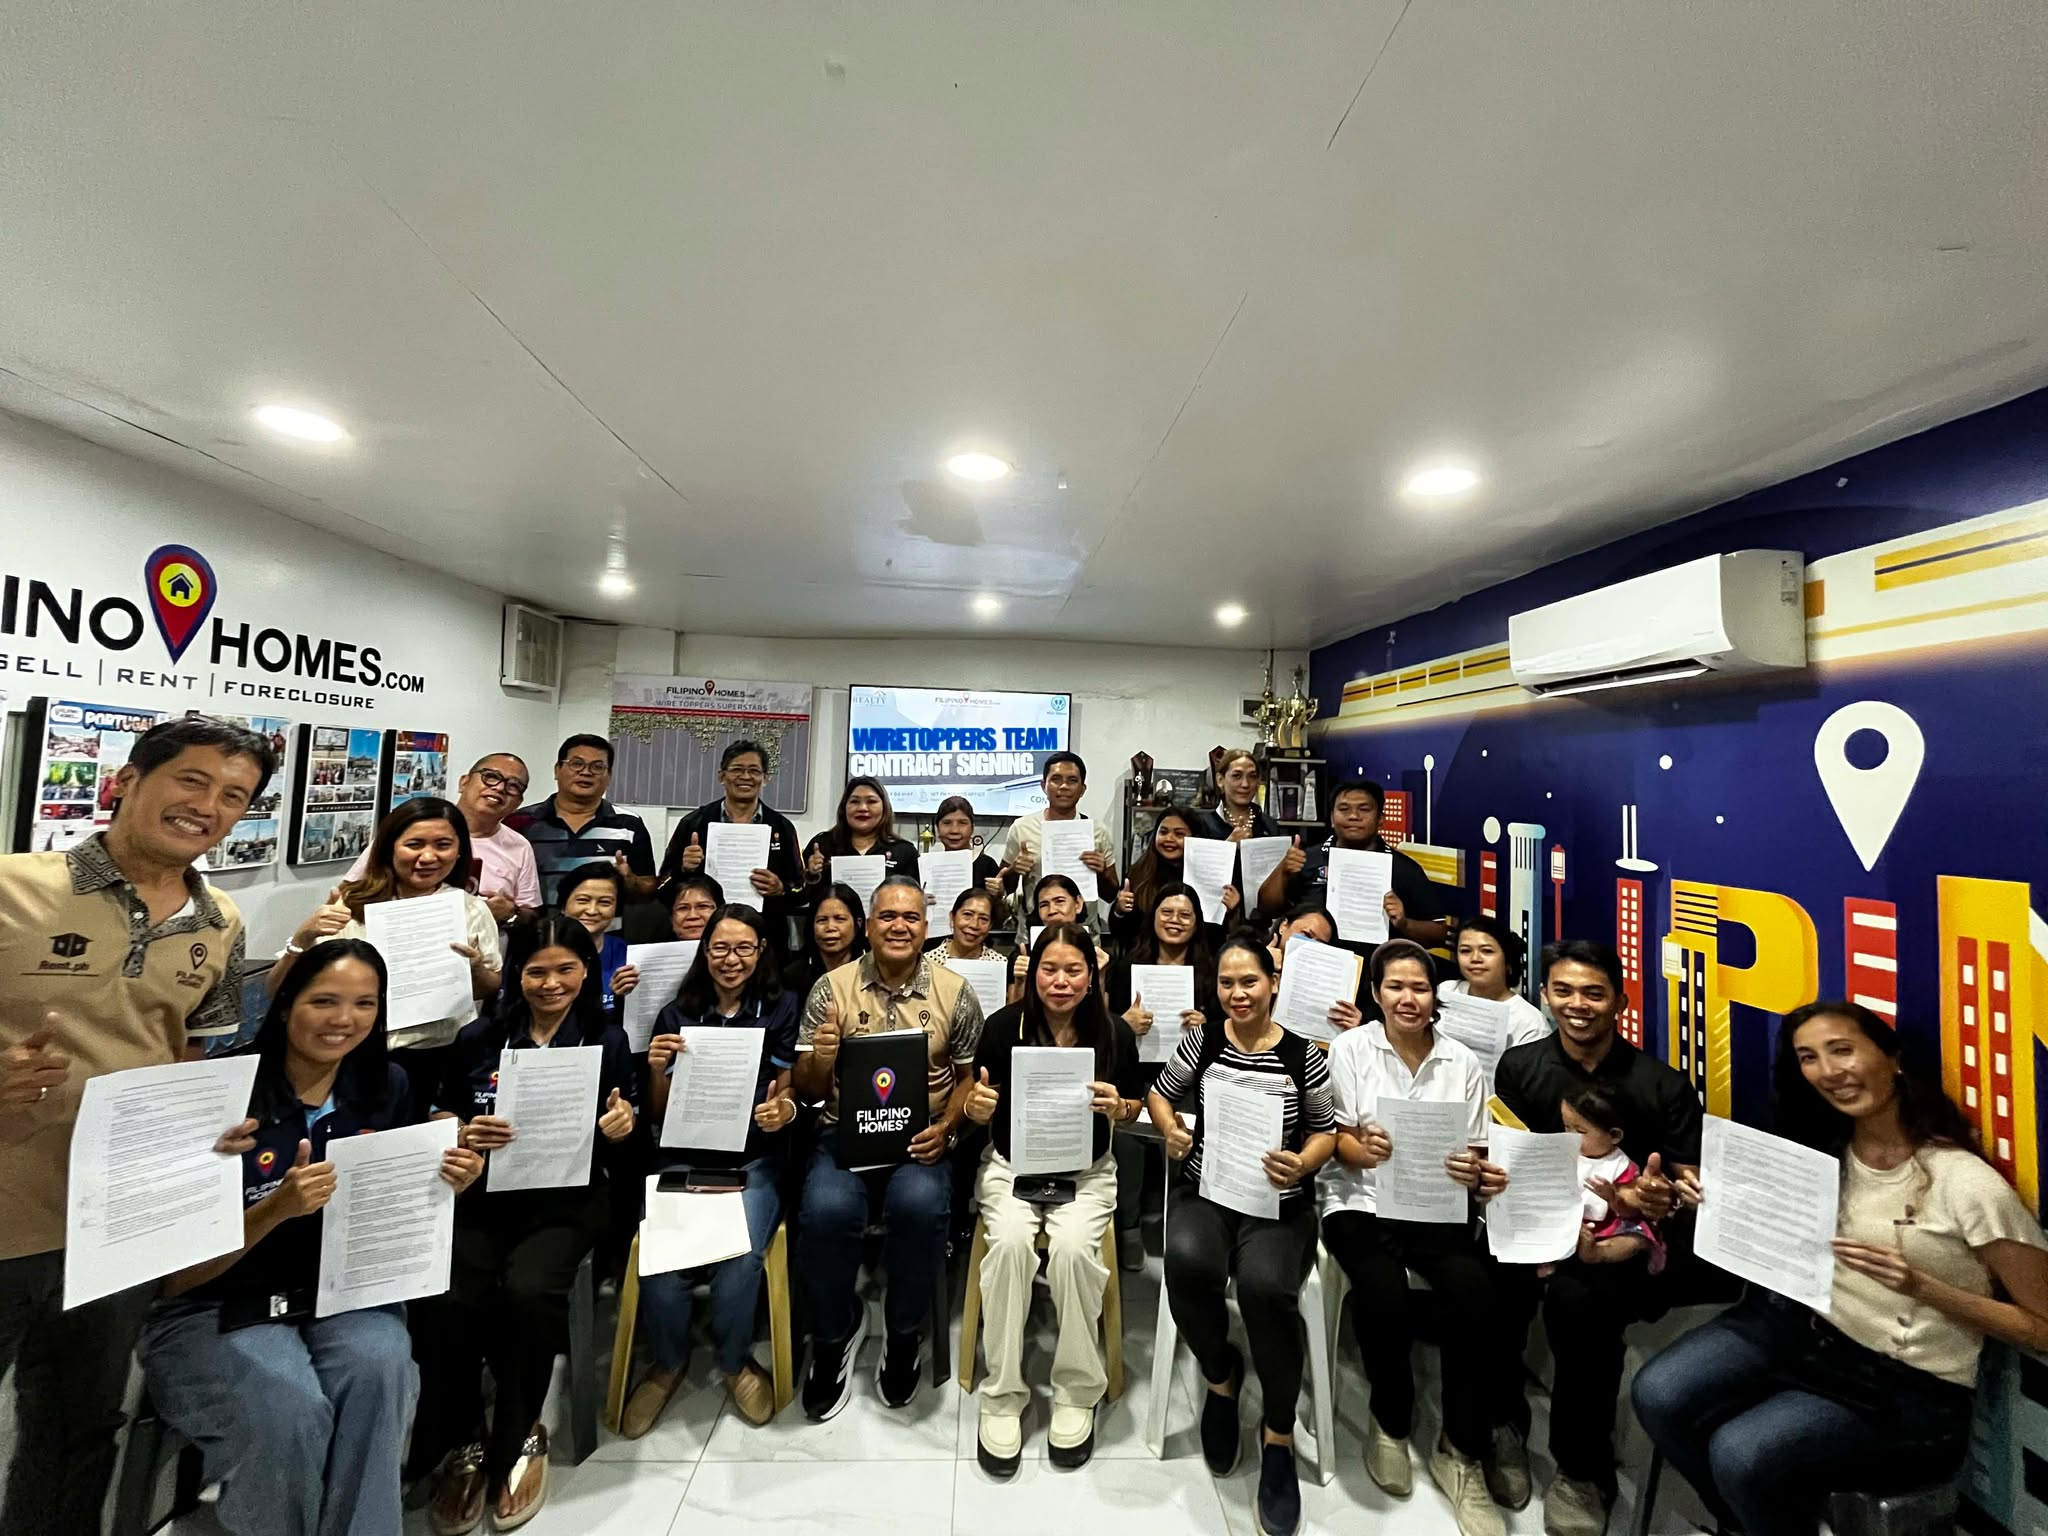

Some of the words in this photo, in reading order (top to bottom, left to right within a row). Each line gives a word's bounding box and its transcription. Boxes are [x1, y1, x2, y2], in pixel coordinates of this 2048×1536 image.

[117, 668, 199, 691] RENT
[224, 680, 375, 709] FORECLOSURE
[667, 687, 705, 695] FILIPINO
[679, 701, 715, 709] TOPPERS
[717, 702, 768, 711] SUPERSTARS
[851, 727, 997, 752] WIRETOPPERS
[1002, 727, 1058, 751] TEAM
[849, 752, 955, 777] CONTRACT
[956, 752, 1034, 776] SIGNING
[856, 1106, 912, 1123] FILIPINO
